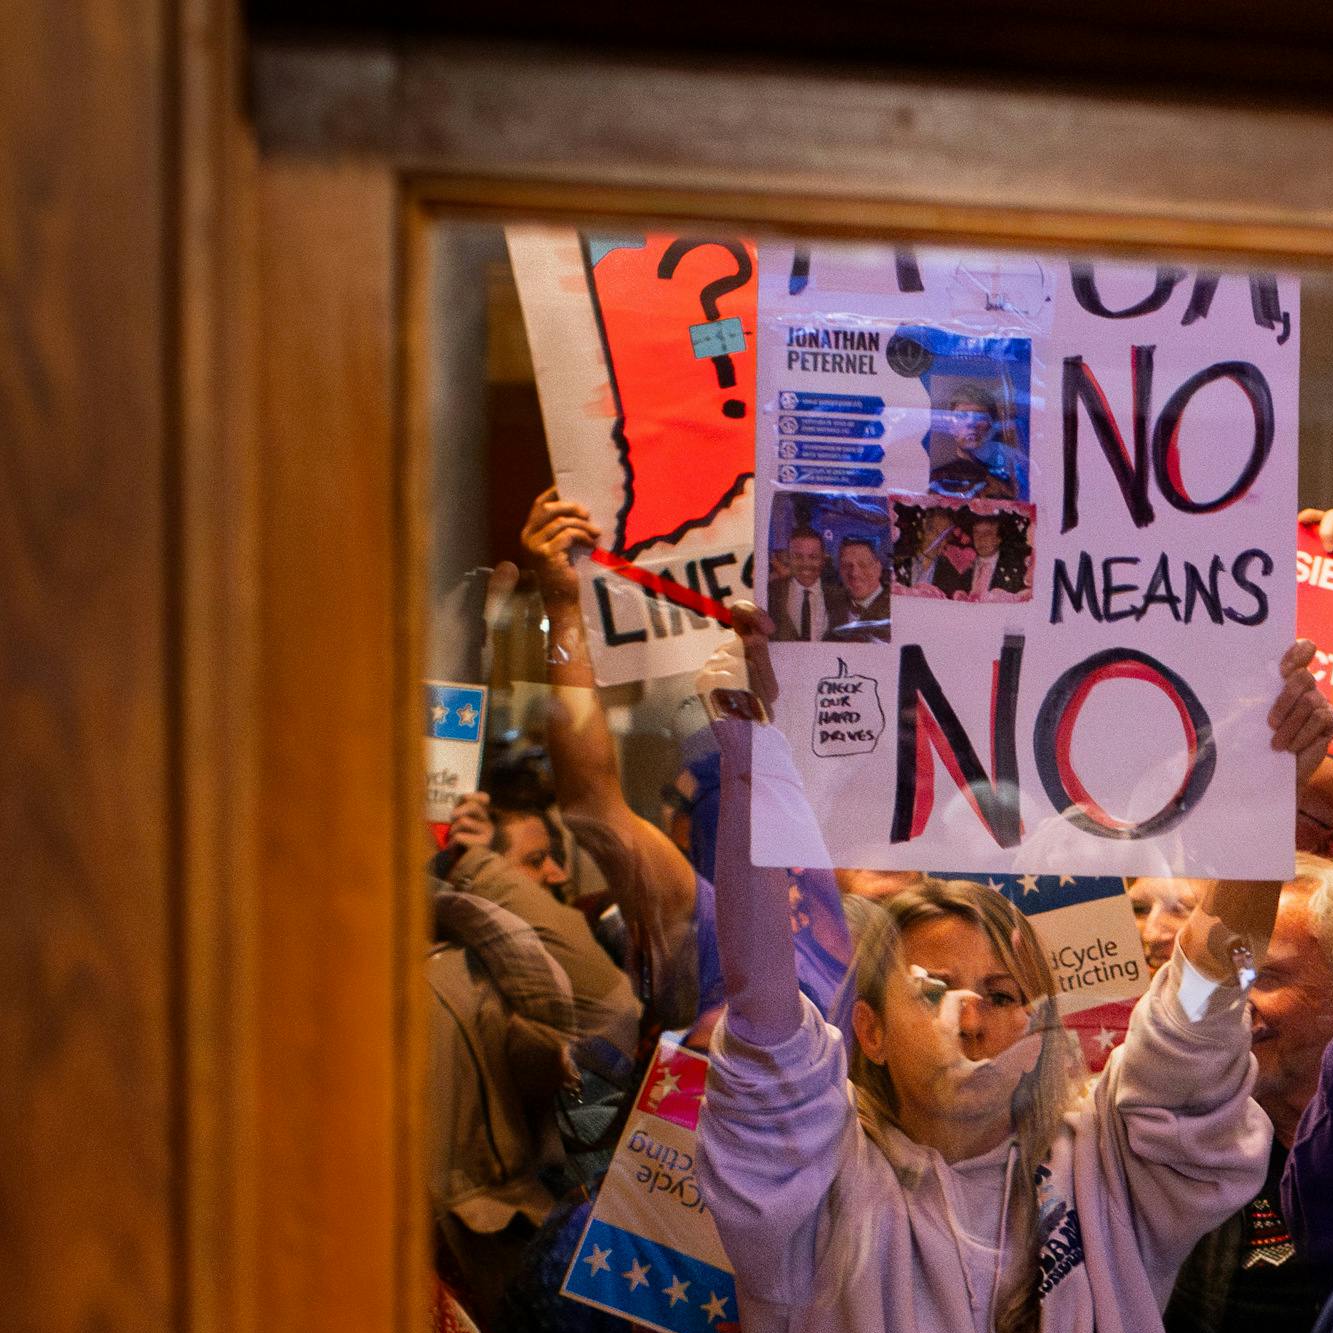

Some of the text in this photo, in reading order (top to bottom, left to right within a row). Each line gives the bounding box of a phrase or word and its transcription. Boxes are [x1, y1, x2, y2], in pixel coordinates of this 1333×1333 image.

[786, 326, 880, 351] JONATHAN
[787, 351, 877, 375] PETERNEL
[1061, 344, 1274, 534] NO
[1049, 547, 1274, 627] MEANS
[889, 632, 1217, 850] NO
[636, 1164, 706, 1214] Cycle
